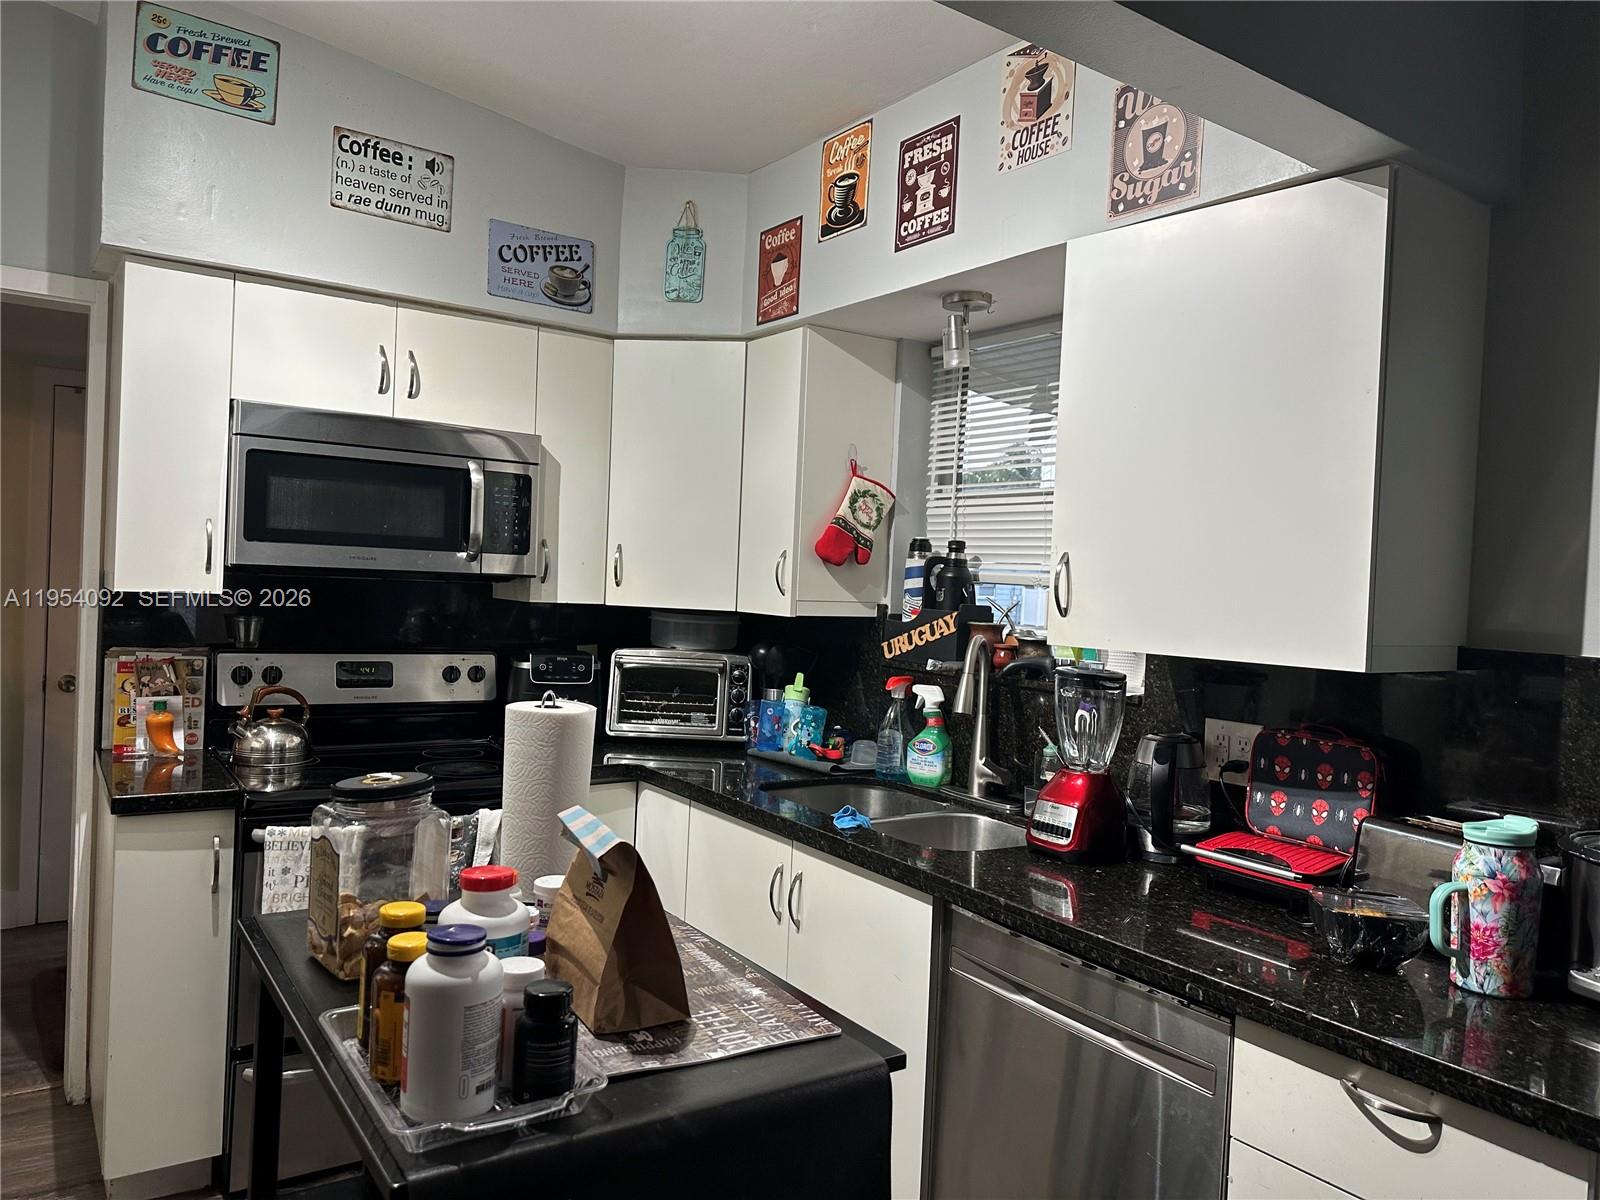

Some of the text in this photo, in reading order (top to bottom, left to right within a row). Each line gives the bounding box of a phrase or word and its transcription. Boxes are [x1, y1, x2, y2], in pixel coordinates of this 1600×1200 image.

[176, 26, 250, 47] Fresh Brewed
[144, 32, 270, 73] COFFEE
[143, 75, 167, 89] Have
[154, 69, 194, 86] HERE
[1010, 113, 1061, 151] COFFEE
[829, 134, 867, 165] Coffee
[904, 134, 953, 169] FRESH
[1016, 140, 1052, 166] HOUSE
[336, 156, 412, 184] (n.) a taste of
[1110, 158, 1196, 206] Sugar
[335, 171, 449, 210] heaven served in
[335, 190, 448, 227] a rae dunn mug.
[900, 206, 949, 237] COFFEE
[765, 228, 797, 249] Coffee
[498, 243, 582, 264] COFFEE
[501, 265, 540, 280] SERVED
[503, 276, 535, 289] HERE
[763, 293, 779, 307] Good
[881, 610, 960, 661] URUGUAY
[914, 741, 935, 752] CLOROX
[272, 892, 310, 904] BRIGH
[690, 1005, 760, 1051] COFFEE
[734, 1000, 790, 1034] LATTE
